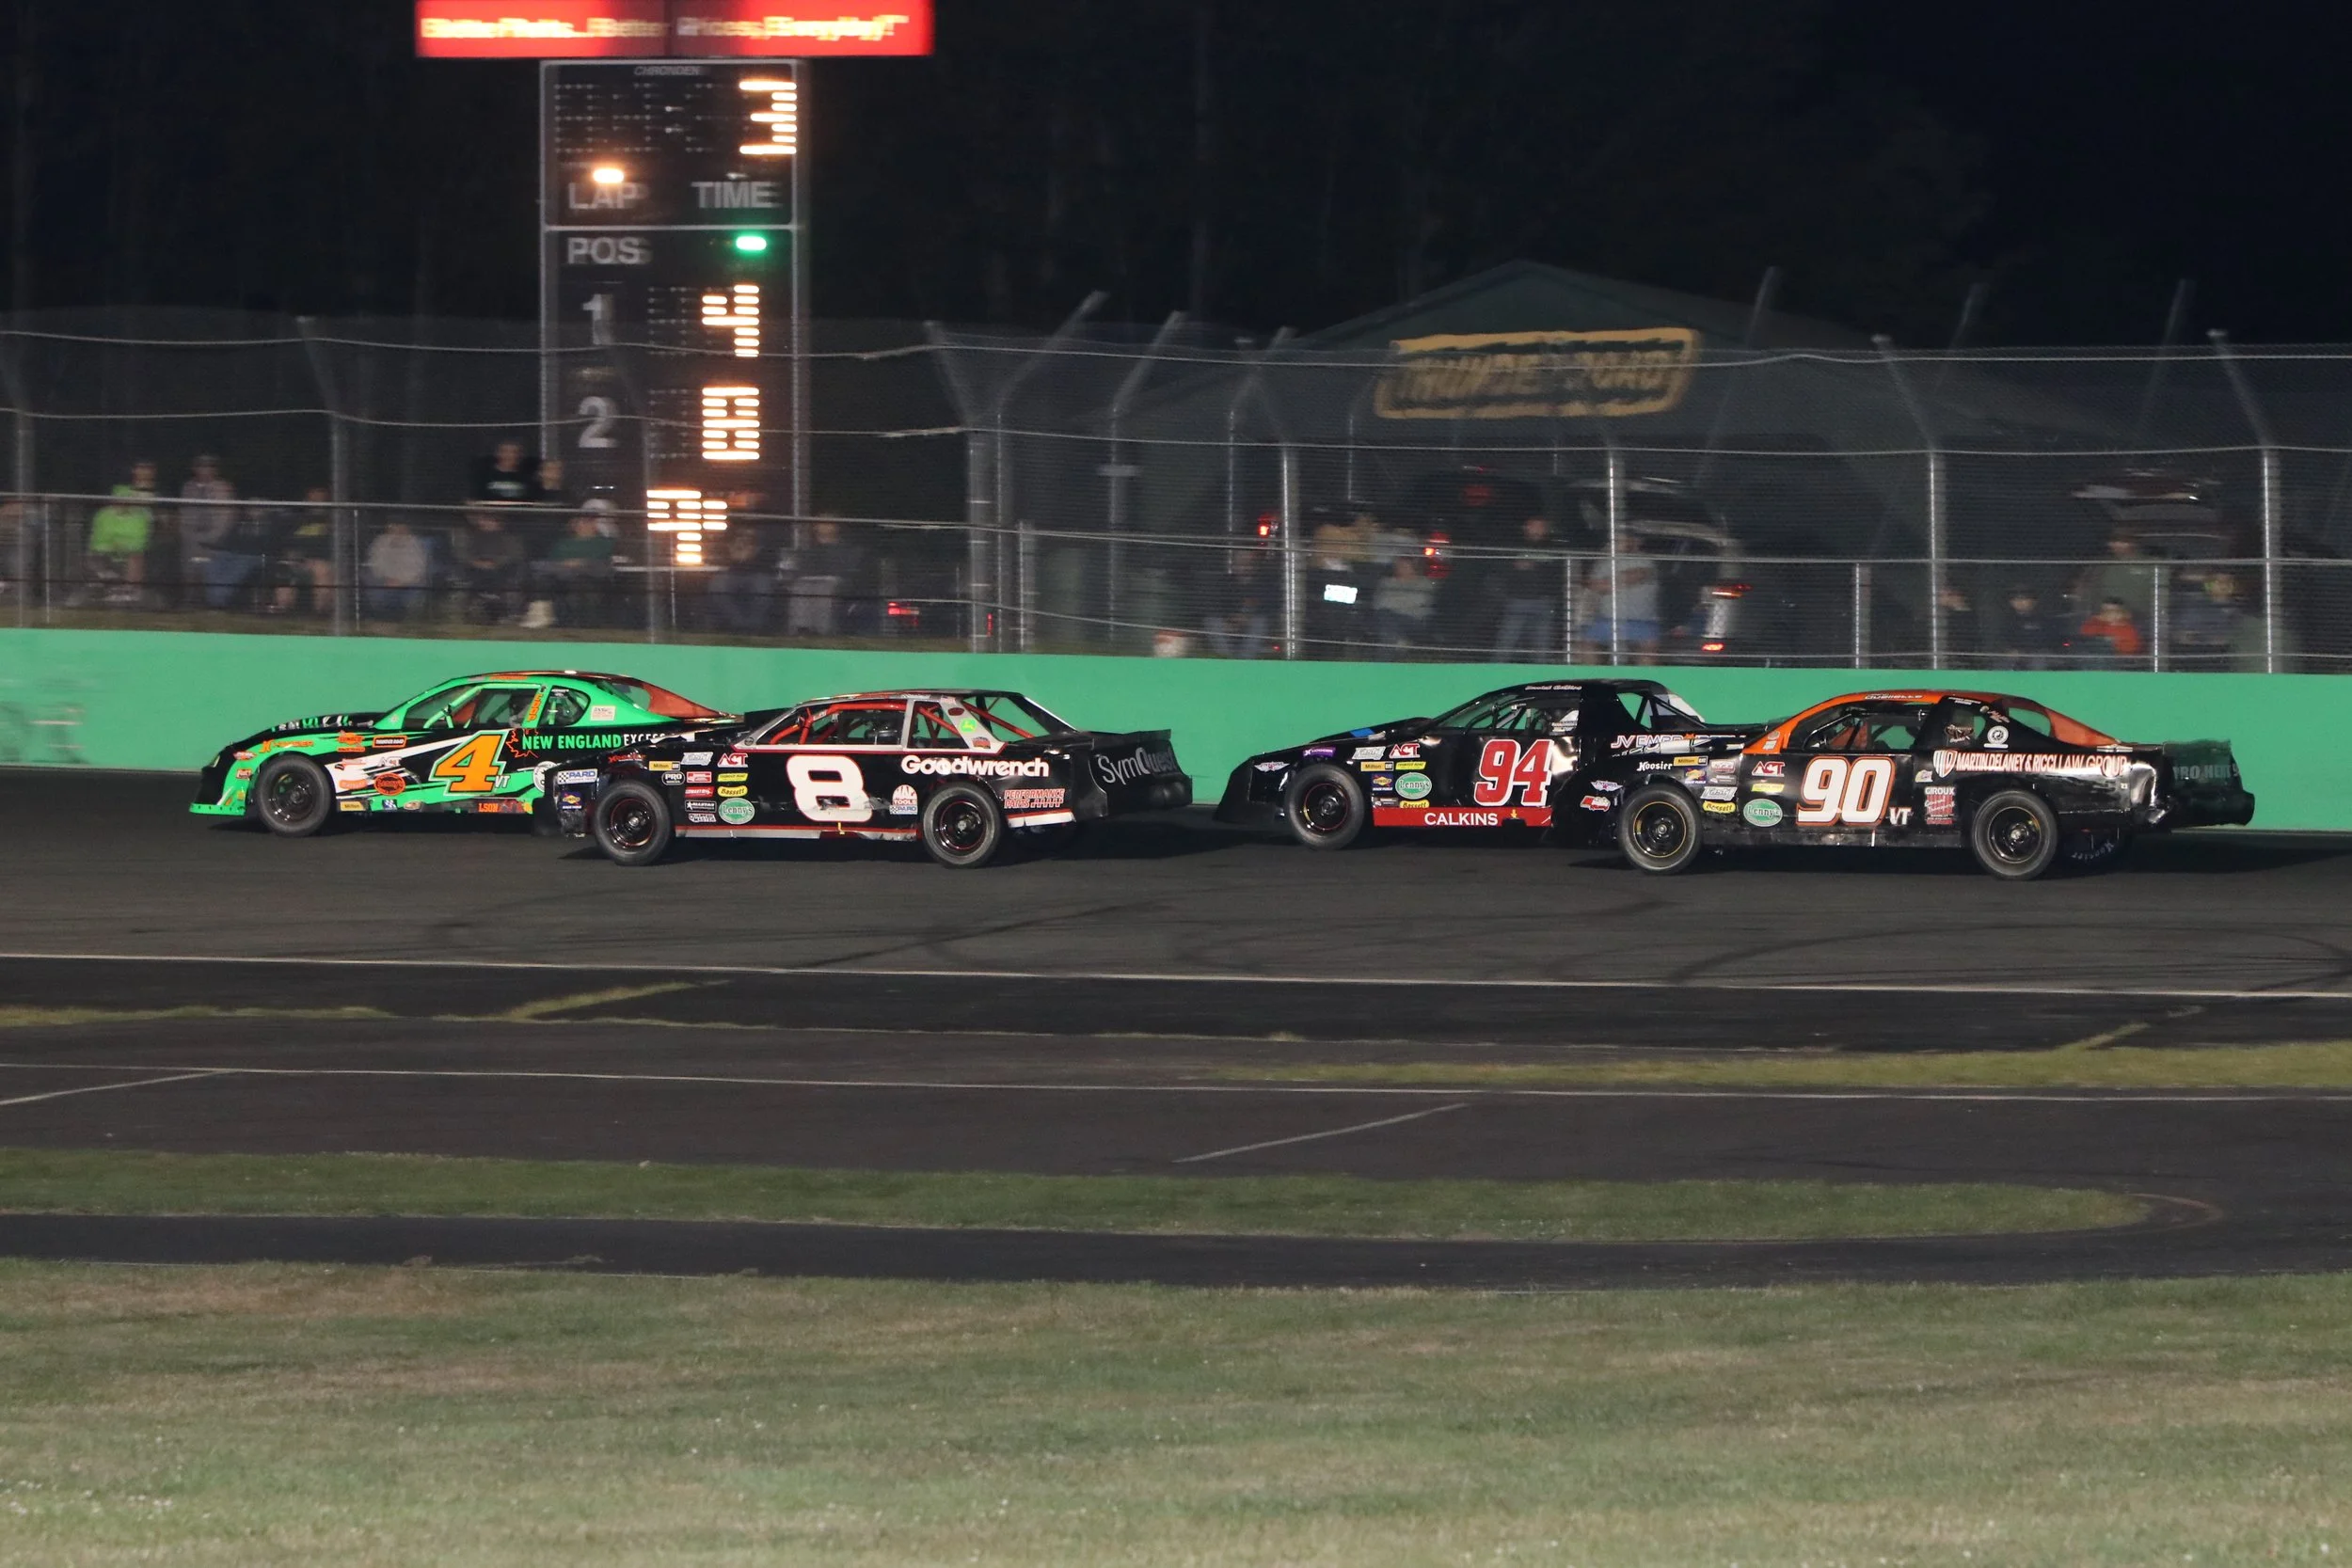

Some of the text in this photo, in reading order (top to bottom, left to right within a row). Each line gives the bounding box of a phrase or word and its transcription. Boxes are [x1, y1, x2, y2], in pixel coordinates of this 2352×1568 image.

[568, 182, 777, 209] LAP TIME
[567, 237, 649, 264] POS
[581, 293, 614, 345] 1
[702, 284, 760, 357] 4
[579, 396, 621, 449] 2
[702, 387, 760, 460] 8
[522, 736, 553, 750] NEW
[558, 734, 622, 749] ENGLAND
[1611, 735, 1636, 749] JV
[1389, 743, 1421, 759] ACT
[430, 729, 509, 798] 4
[717, 752, 749, 768] ACT
[901, 754, 1049, 777] Goodwrench
[1098, 747, 1176, 785] SymQuest
[1637, 761, 1673, 771] Hoosier
[2058, 754, 2085, 770] LAW
[2086, 755, 2127, 777] GROUP
[569, 770, 596, 779] PARD
[1473, 738, 1554, 807] 94
[1752, 761, 1786, 777] ACT
[495, 775, 511, 788] VT
[785, 754, 872, 822] 8
[1399, 779, 1429, 790] Lenny's
[721, 787, 745, 796] Bassett
[1004, 789, 1065, 799] PERFORMANCE
[1795, 755, 1896, 826] 90
[1925, 786, 1956, 795] GIROUX
[723, 805, 753, 816] Lenny's
[1004, 799, 1030, 808] PARTS
[1424, 812, 1498, 826] CALKINS
[1889, 808, 1912, 825] VT
